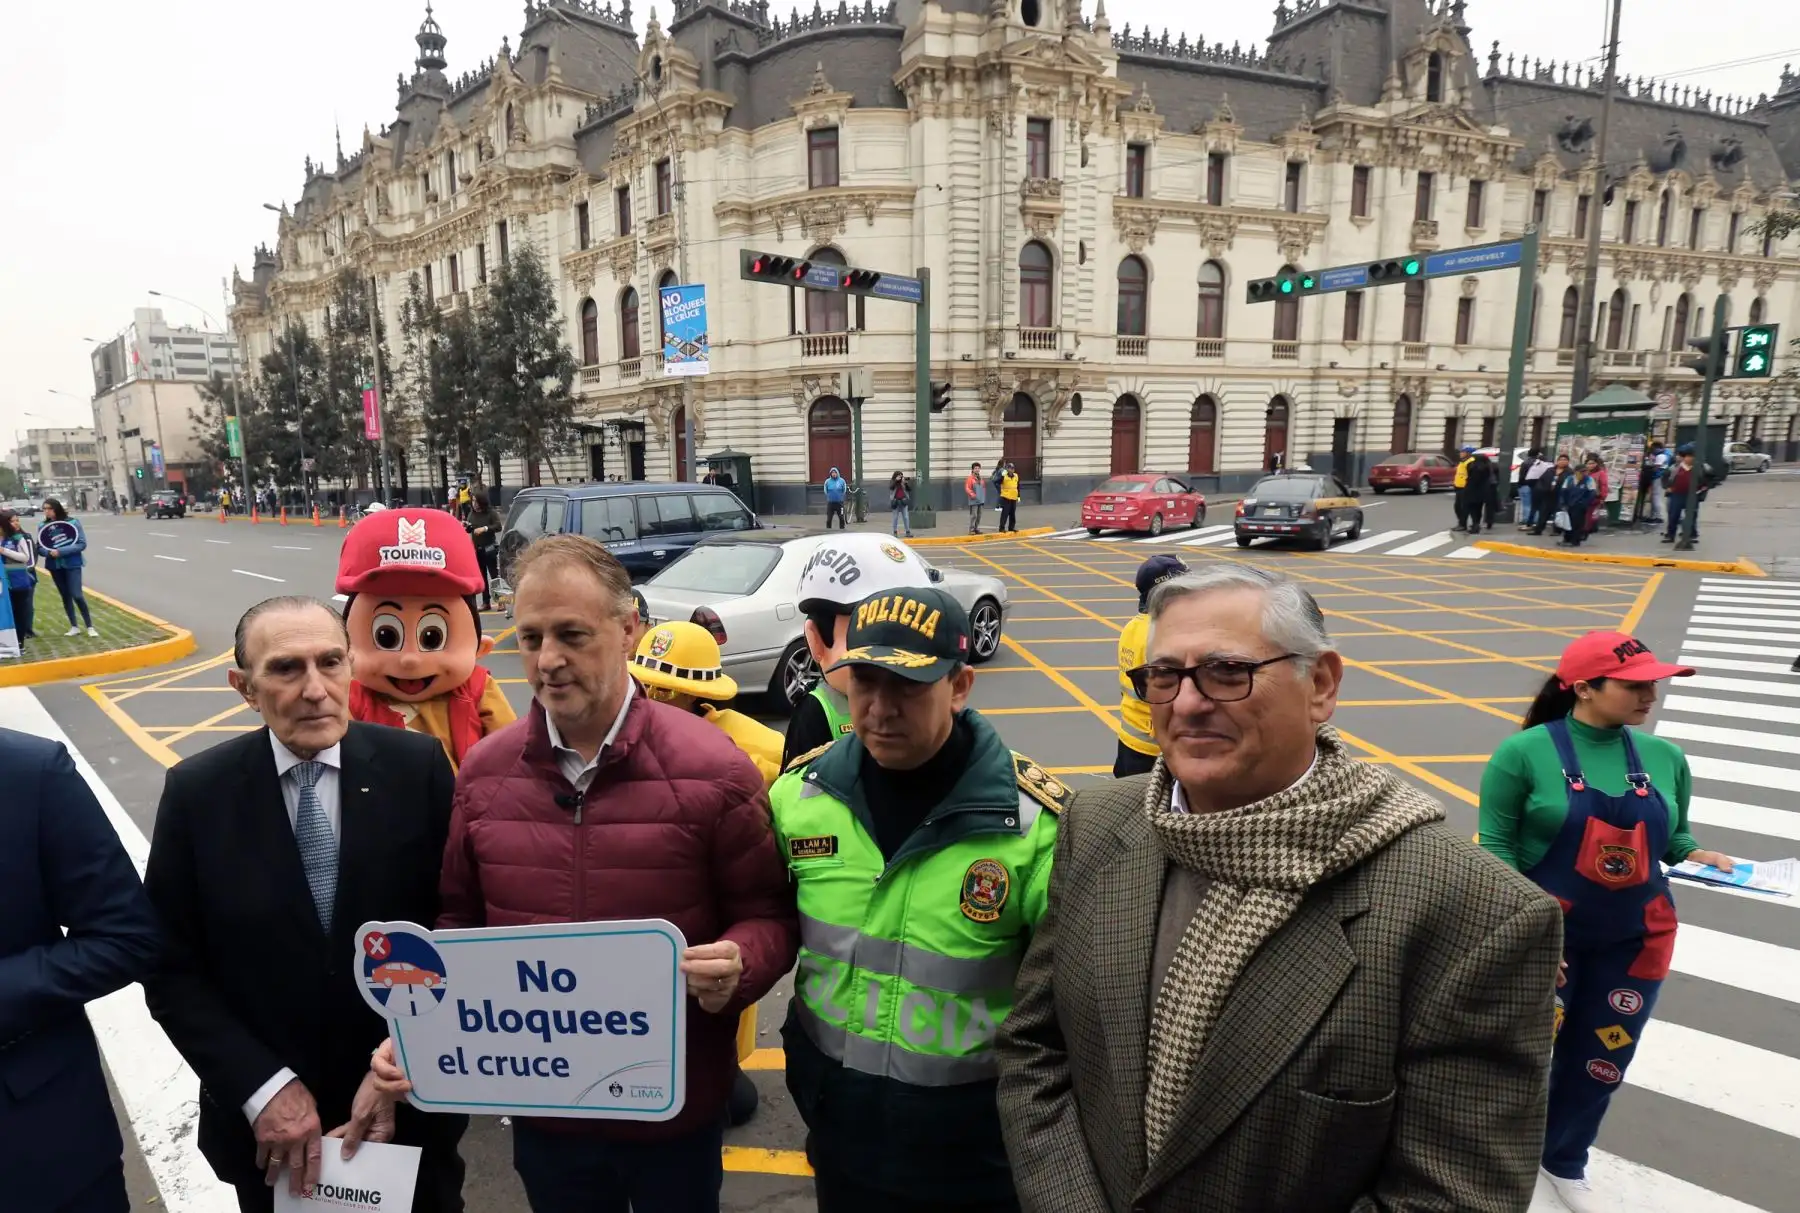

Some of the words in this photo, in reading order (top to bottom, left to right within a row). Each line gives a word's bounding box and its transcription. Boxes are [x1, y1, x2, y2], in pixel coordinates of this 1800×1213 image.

[1458, 252, 1506, 264] ROOSEVELT
[662, 292, 681, 309] NO
[664, 297, 705, 318] BLOQUEES
[666, 316, 676, 326] EL
[675, 308, 700, 322] CRUCE
[382, 549, 442, 560] TOURING
[856, 595, 941, 640] POLICIA
[803, 839, 820, 849] LAM
[516, 960, 577, 993] No
[804, 964, 998, 1050] OLICIA
[456, 999, 650, 1043] bloquees
[437, 1046, 469, 1076] el
[476, 1055, 571, 1078] cruce
[1590, 1063, 1617, 1079] PARE
[630, 1089, 664, 1100] LIMA
[315, 1183, 382, 1205] TOURING
